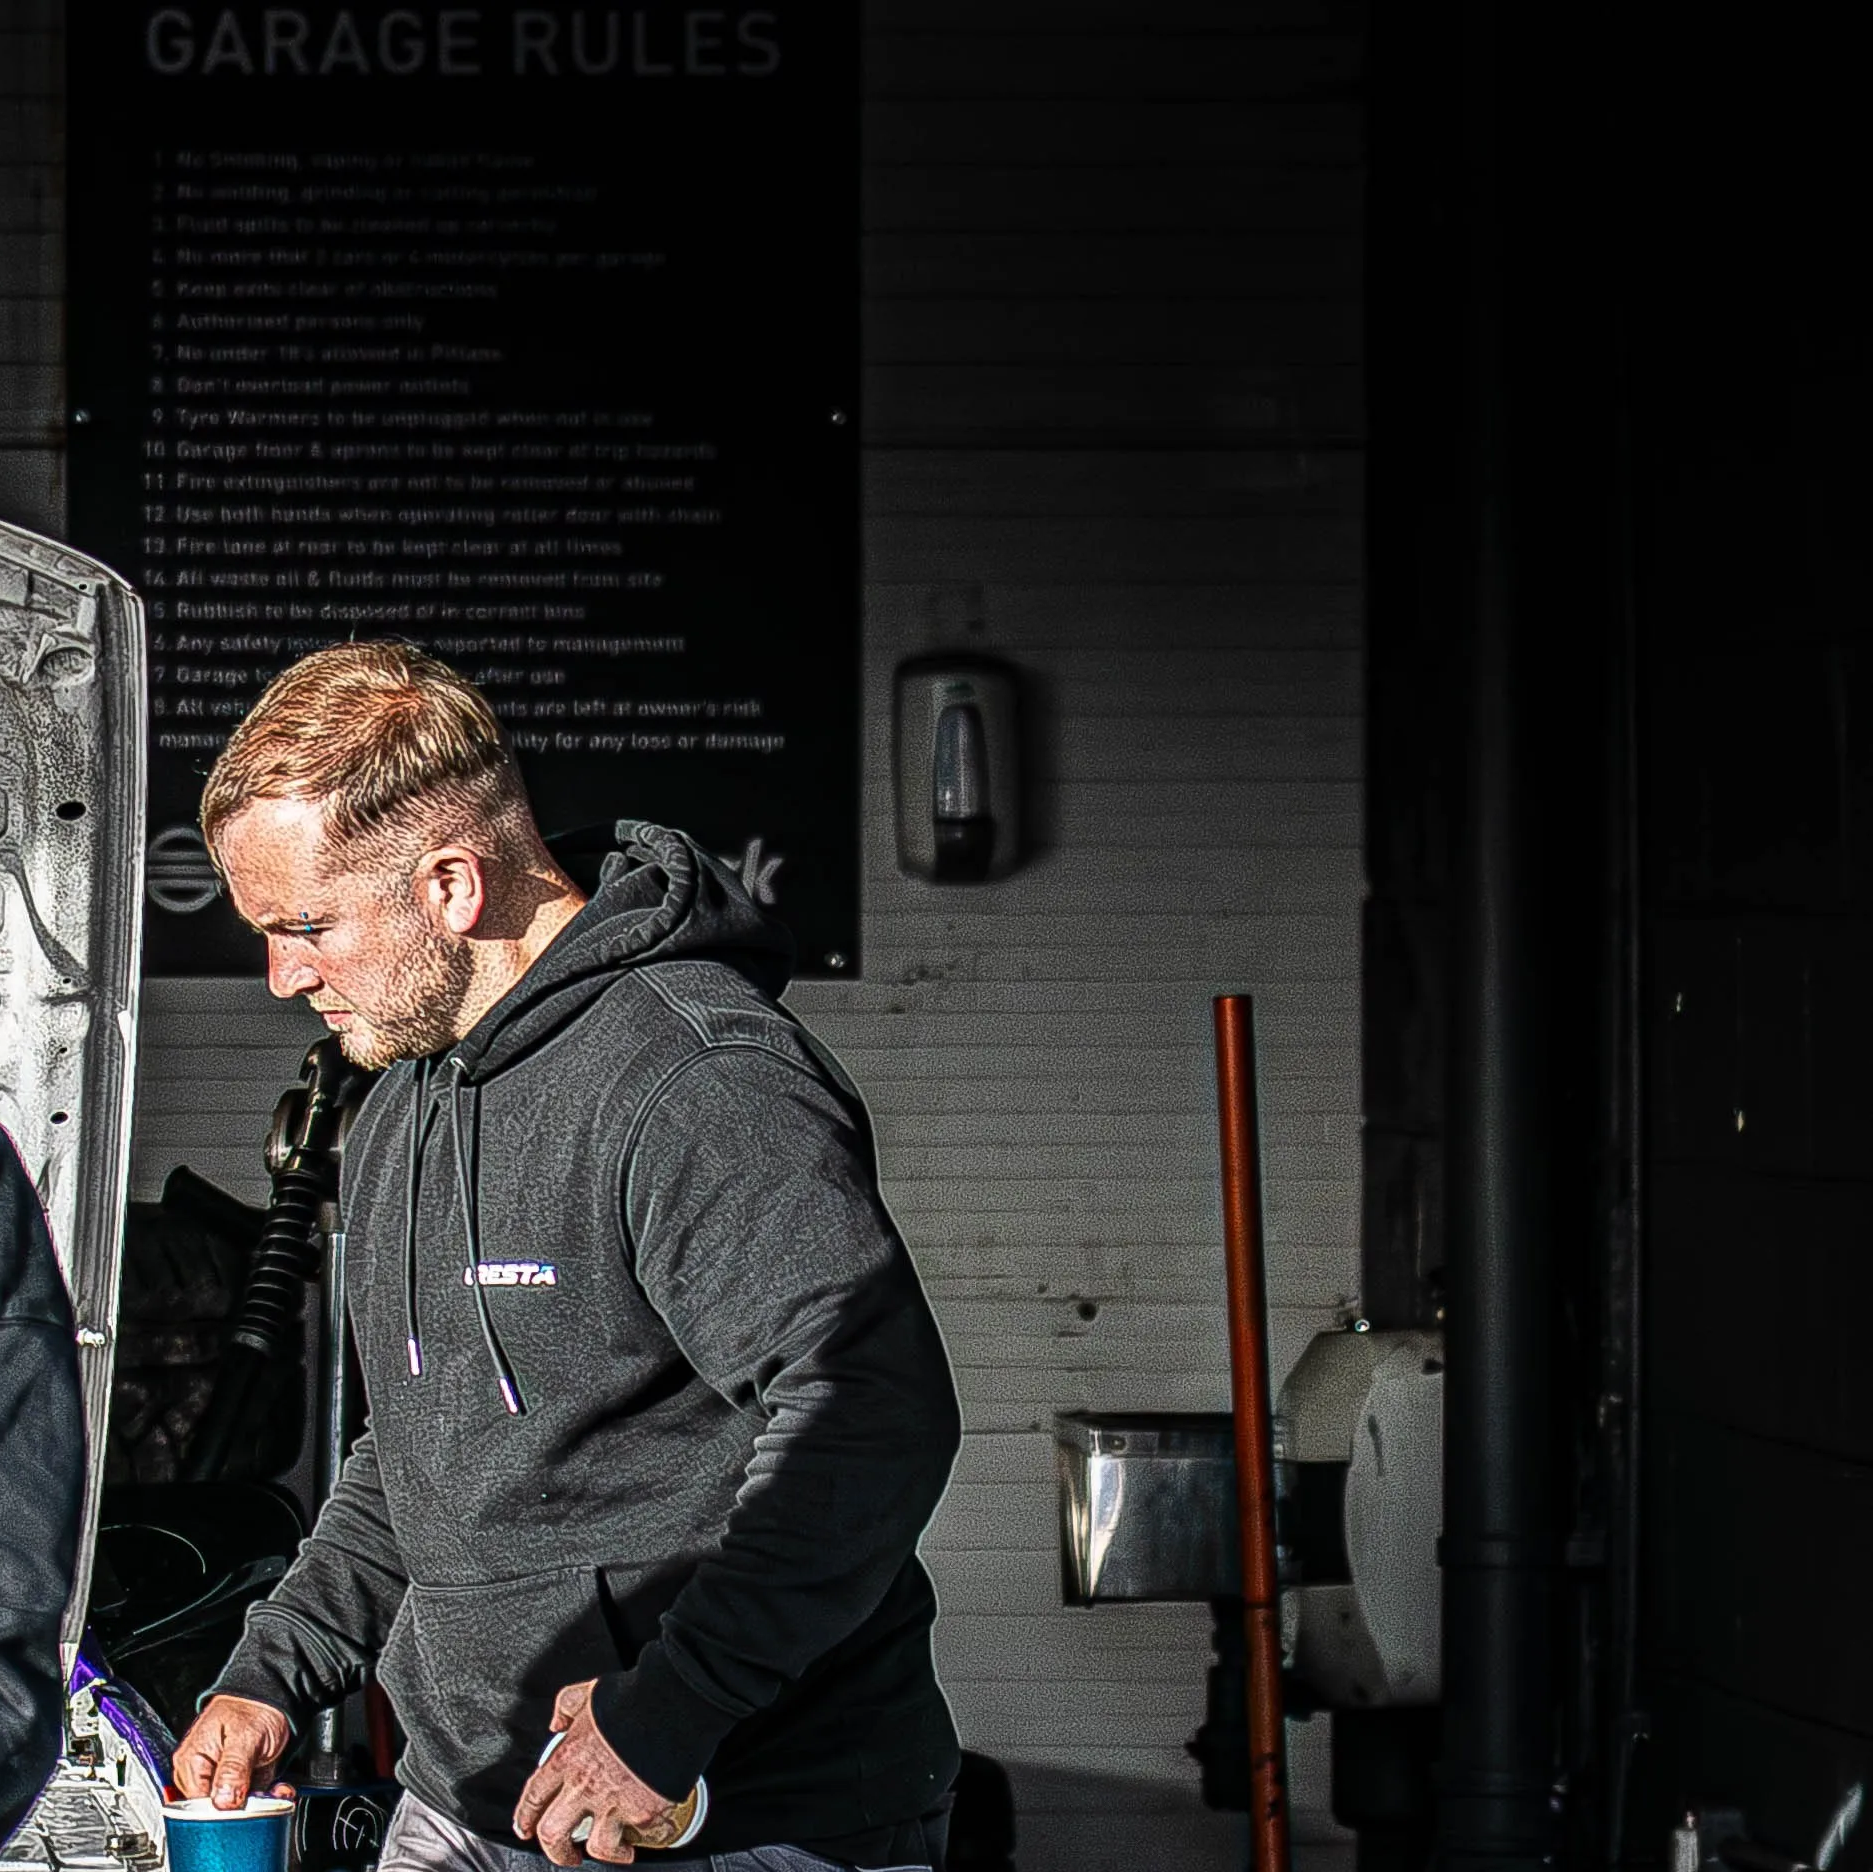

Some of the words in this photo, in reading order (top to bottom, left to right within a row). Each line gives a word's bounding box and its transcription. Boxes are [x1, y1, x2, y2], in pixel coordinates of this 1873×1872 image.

[144, 8, 484, 77] GARAGE
[511, 8, 782, 77] RULES
[175, 473, 217, 491] Fire
[175, 505, 215, 523] Use
[175, 537, 217, 555] Fire
[222, 537, 268, 555] lane
[175, 569, 205, 588] All
[306, 569, 323, 588] &
[175, 634, 214, 656] Any
[176, 666, 248, 688] Garage
[176, 697, 204, 716] All
[532, 700, 567, 716] are
[554, 731, 582, 749] for
[587, 734, 627, 753] any
[630, 731, 673, 749] loss
[676, 734, 701, 749] or
[704, 731, 786, 753] damage
